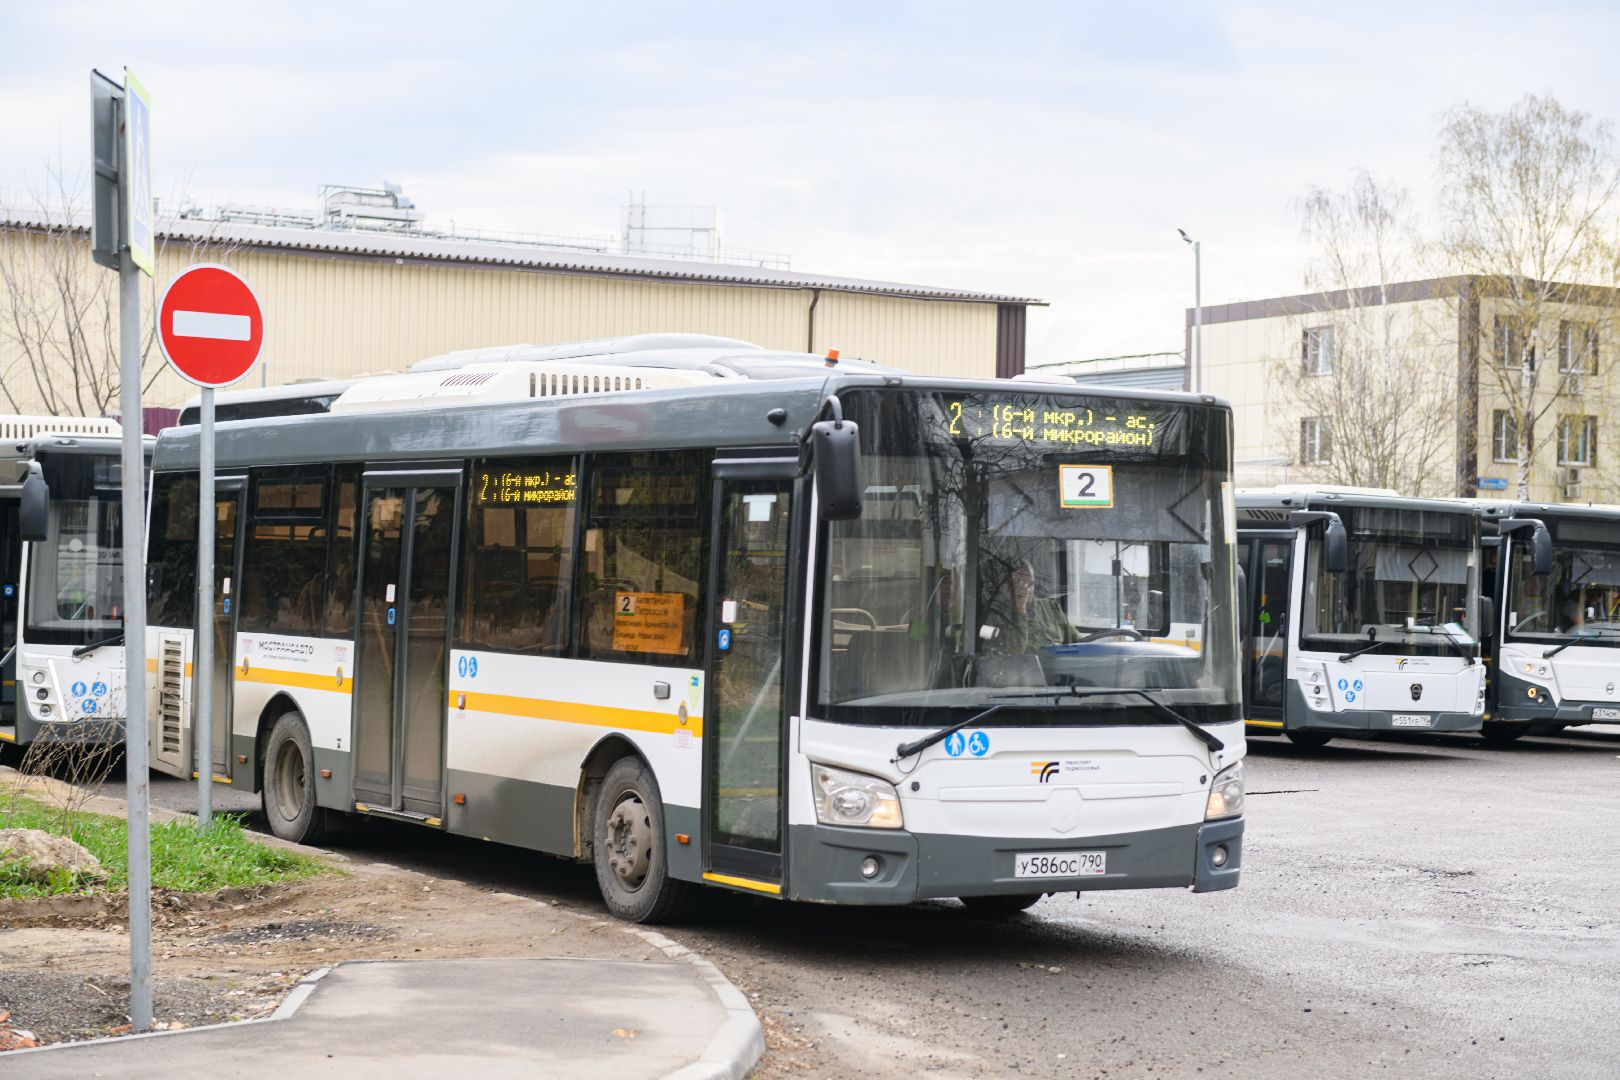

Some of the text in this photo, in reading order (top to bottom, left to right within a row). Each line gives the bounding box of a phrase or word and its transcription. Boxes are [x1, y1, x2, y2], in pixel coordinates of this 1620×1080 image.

[950, 402, 962, 435] 2
[993, 405, 1035, 423] (6-й
[1043, 409, 1093, 427] мкр.)
[992, 422, 1034, 441] (6-й
[1043, 428, 1154, 446] микрорайон)
[480, 473, 490, 501] 2
[1077, 472, 1097, 497] 2
[622, 596, 630, 612] 2
